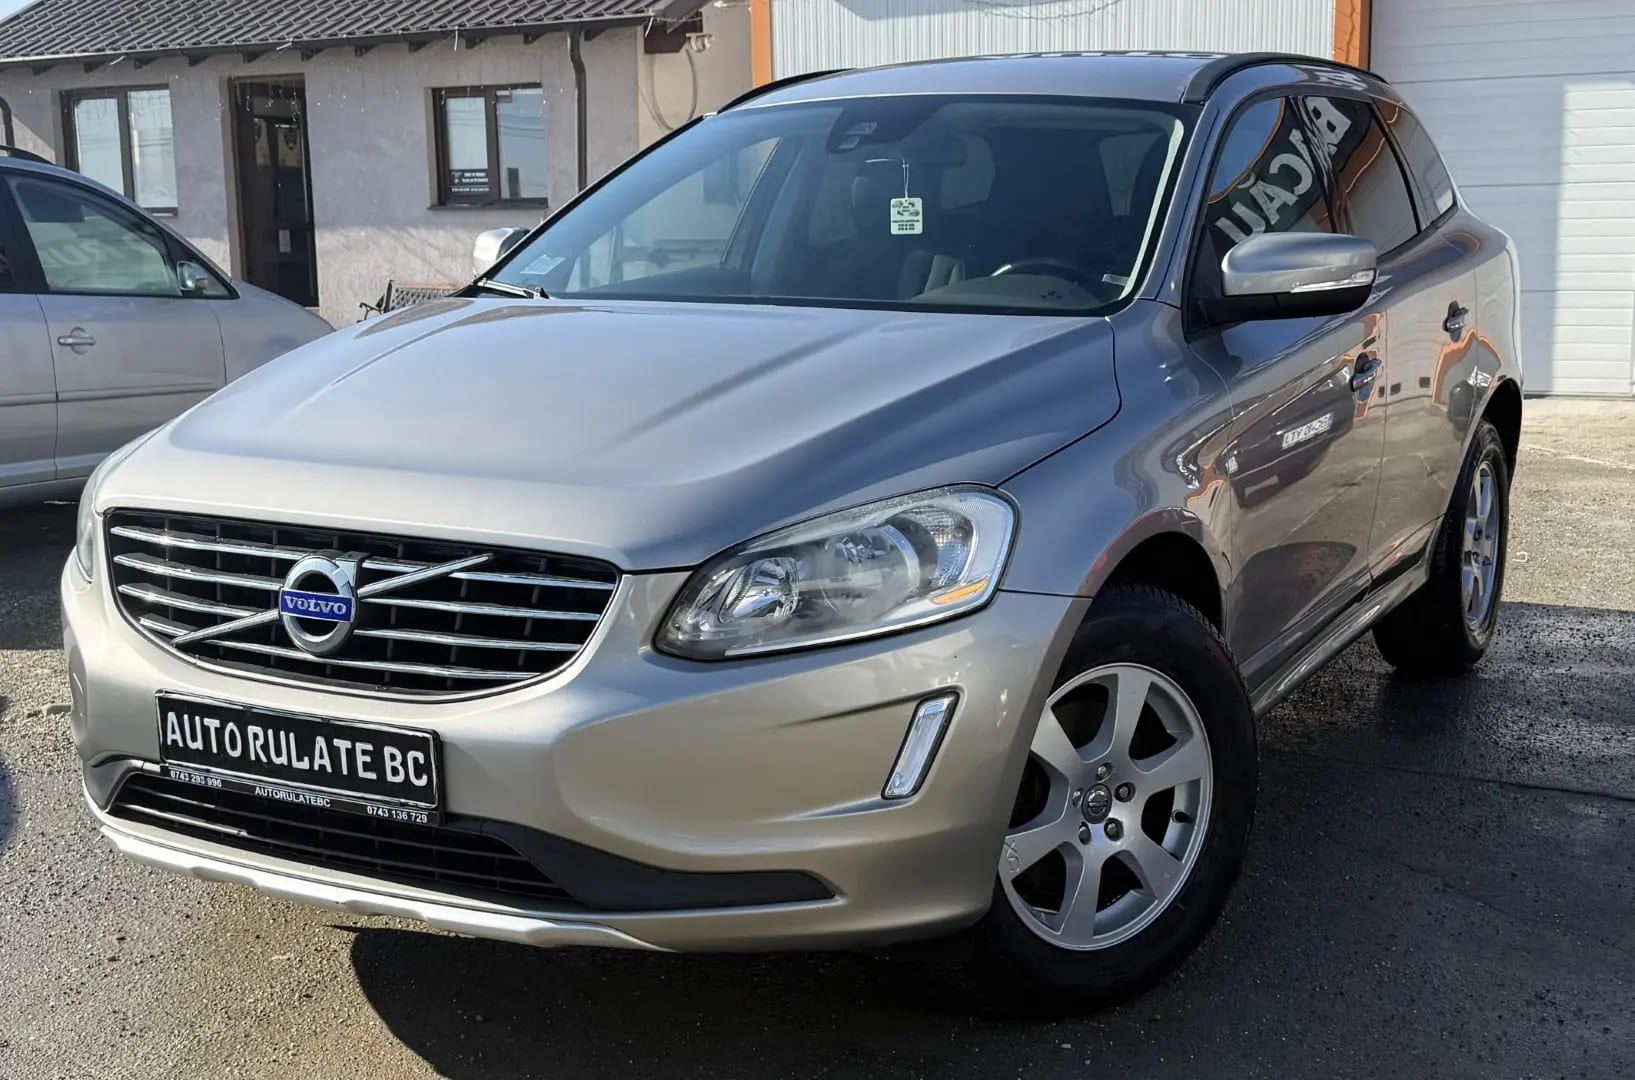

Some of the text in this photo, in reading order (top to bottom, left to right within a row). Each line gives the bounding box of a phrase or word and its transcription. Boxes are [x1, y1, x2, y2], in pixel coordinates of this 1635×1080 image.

[284, 595, 347, 615] VOLVO
[170, 770, 189, 781] 0743
[383, 746, 428, 787] BC
[255, 786, 331, 808] AUTORULATEBC
[367, 805, 428, 823] 0743 136 729
